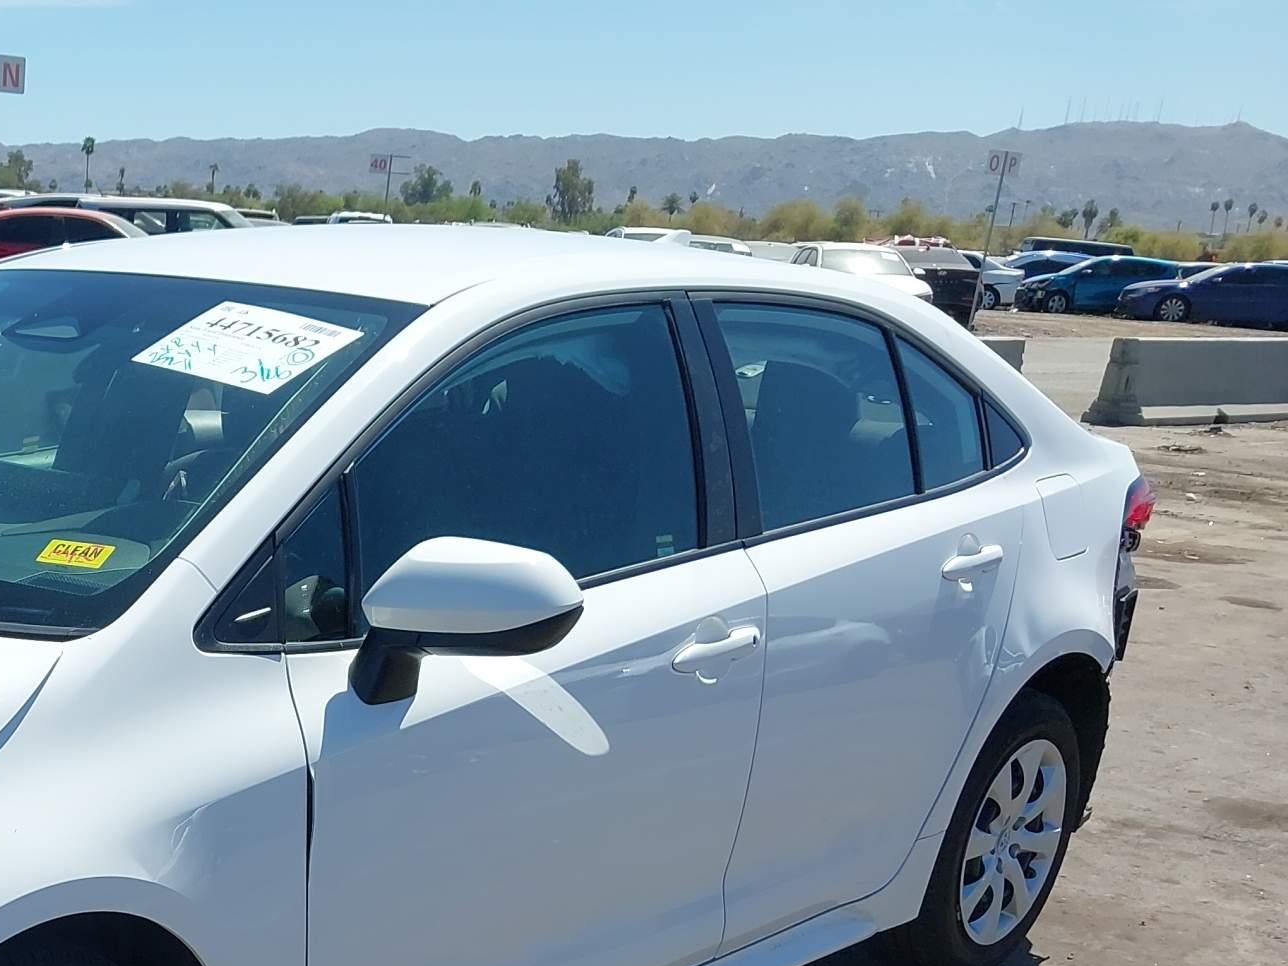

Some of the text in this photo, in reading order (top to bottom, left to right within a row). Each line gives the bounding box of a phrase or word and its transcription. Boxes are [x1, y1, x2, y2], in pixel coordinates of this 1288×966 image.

[2, 62, 20, 88] N
[370, 158, 388, 169] 40
[1008, 156, 1017, 173] P
[206, 316, 321, 350] 44715682
[52, 543, 104, 559] CLEAN
